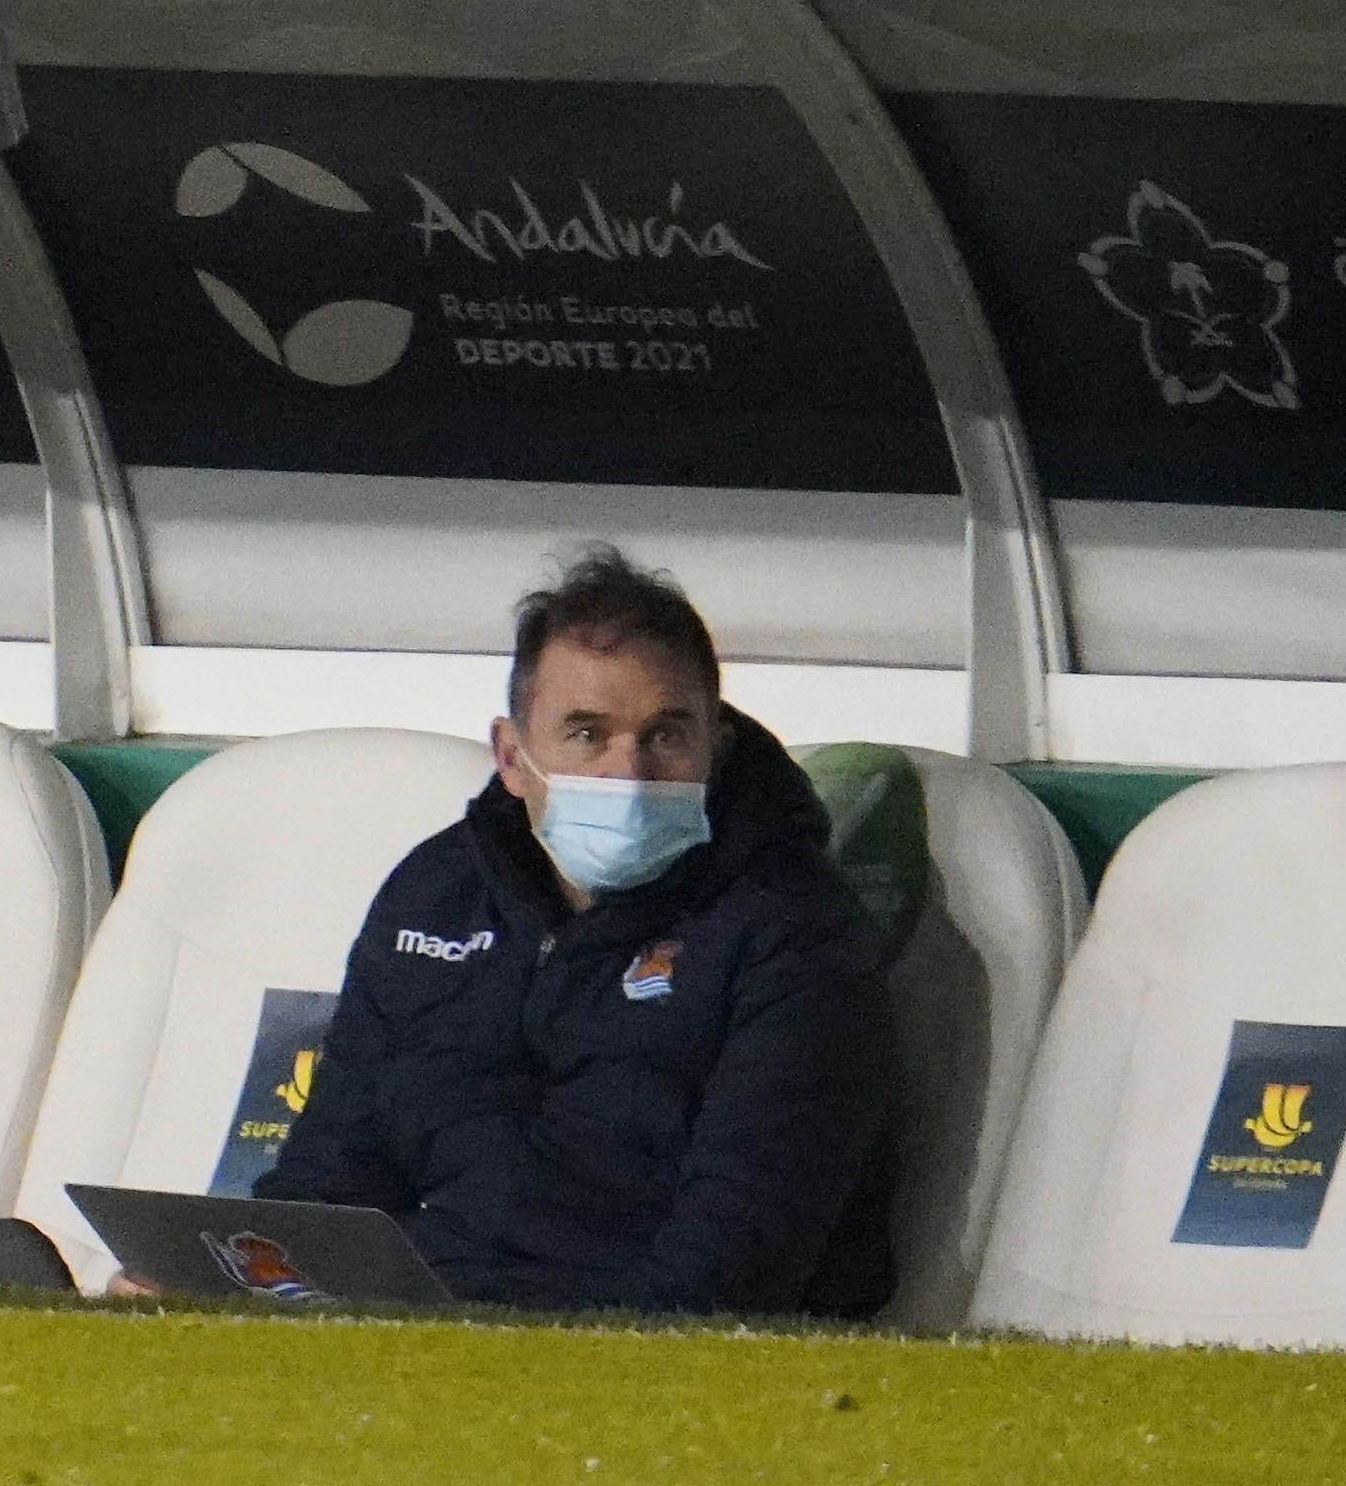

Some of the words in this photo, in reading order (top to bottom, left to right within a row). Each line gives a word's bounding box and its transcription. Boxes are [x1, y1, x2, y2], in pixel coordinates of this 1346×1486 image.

[439, 292, 553, 330] Región
[707, 302, 760, 330] del
[455, 337, 620, 372] DEPORTE
[625, 339, 712, 373] 2021
